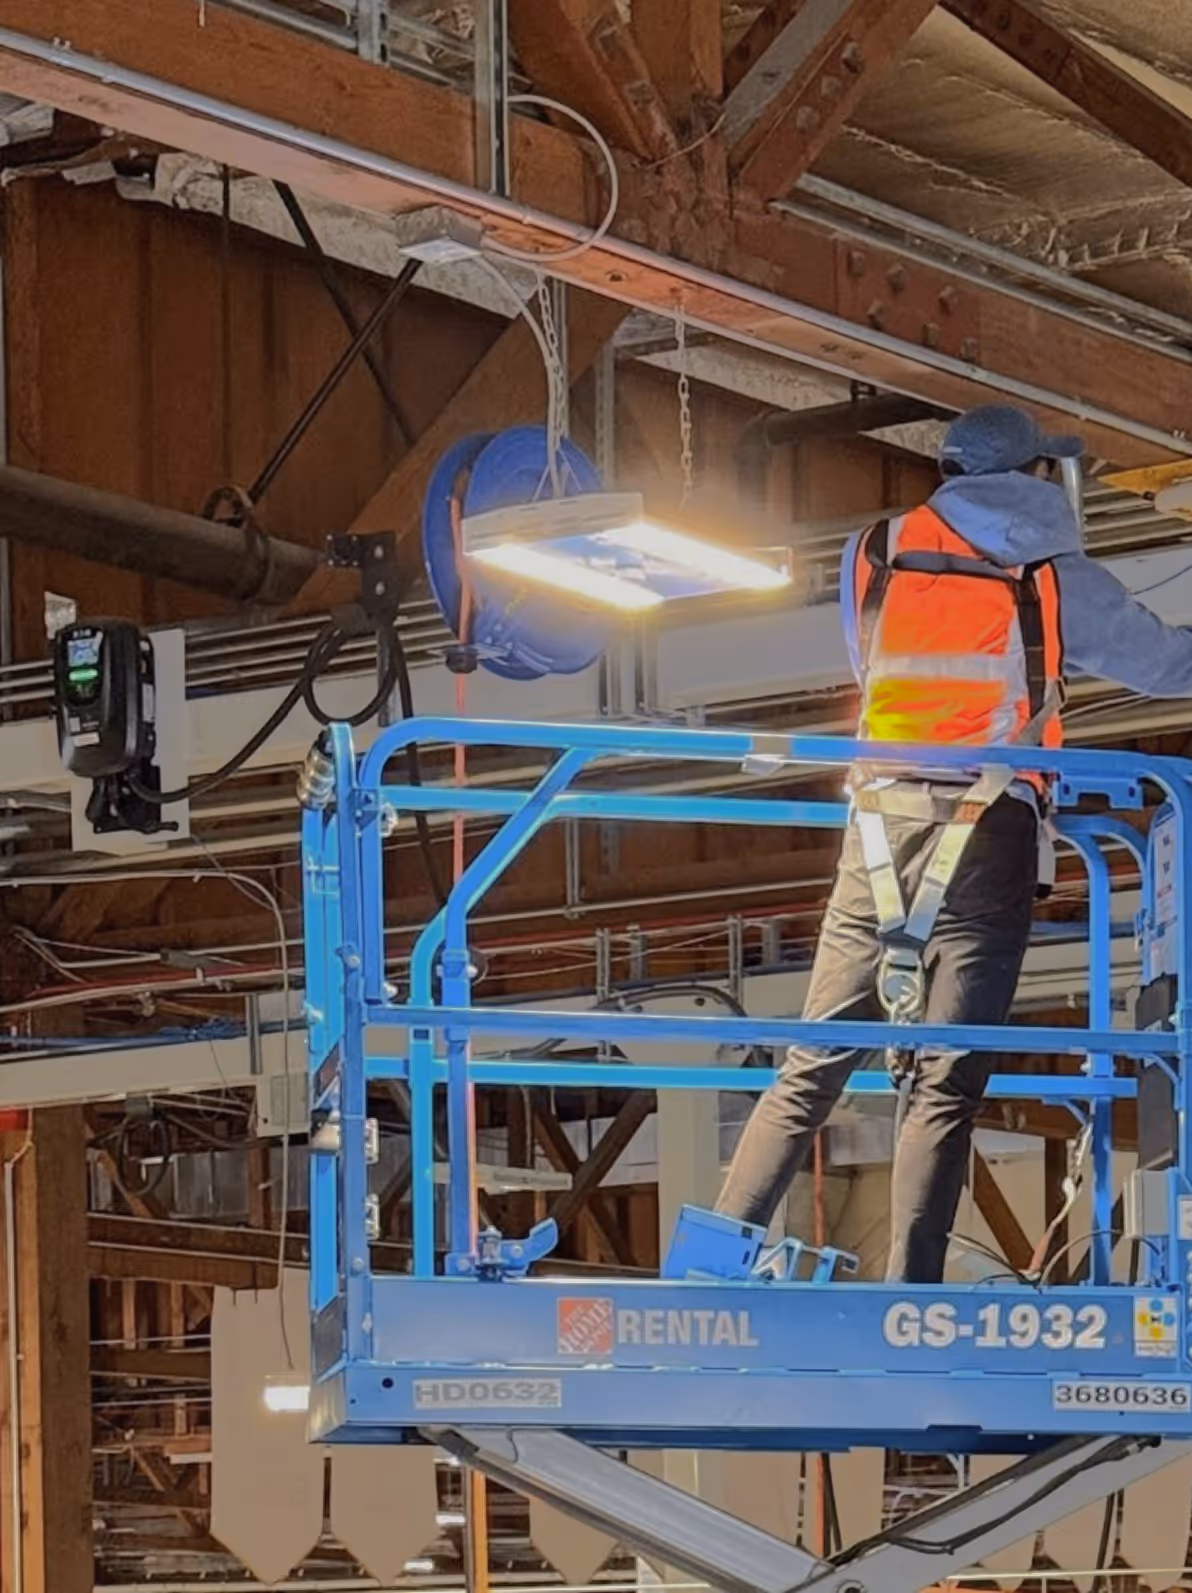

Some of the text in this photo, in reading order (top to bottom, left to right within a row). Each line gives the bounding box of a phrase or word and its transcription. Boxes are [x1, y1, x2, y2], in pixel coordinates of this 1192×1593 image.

[617, 1309, 760, 1347] RENTAL
[883, 1302, 1107, 1350] GS-1932
[415, 1381, 558, 1402] HD0632
[1056, 1385, 1187, 1405] 3680636
